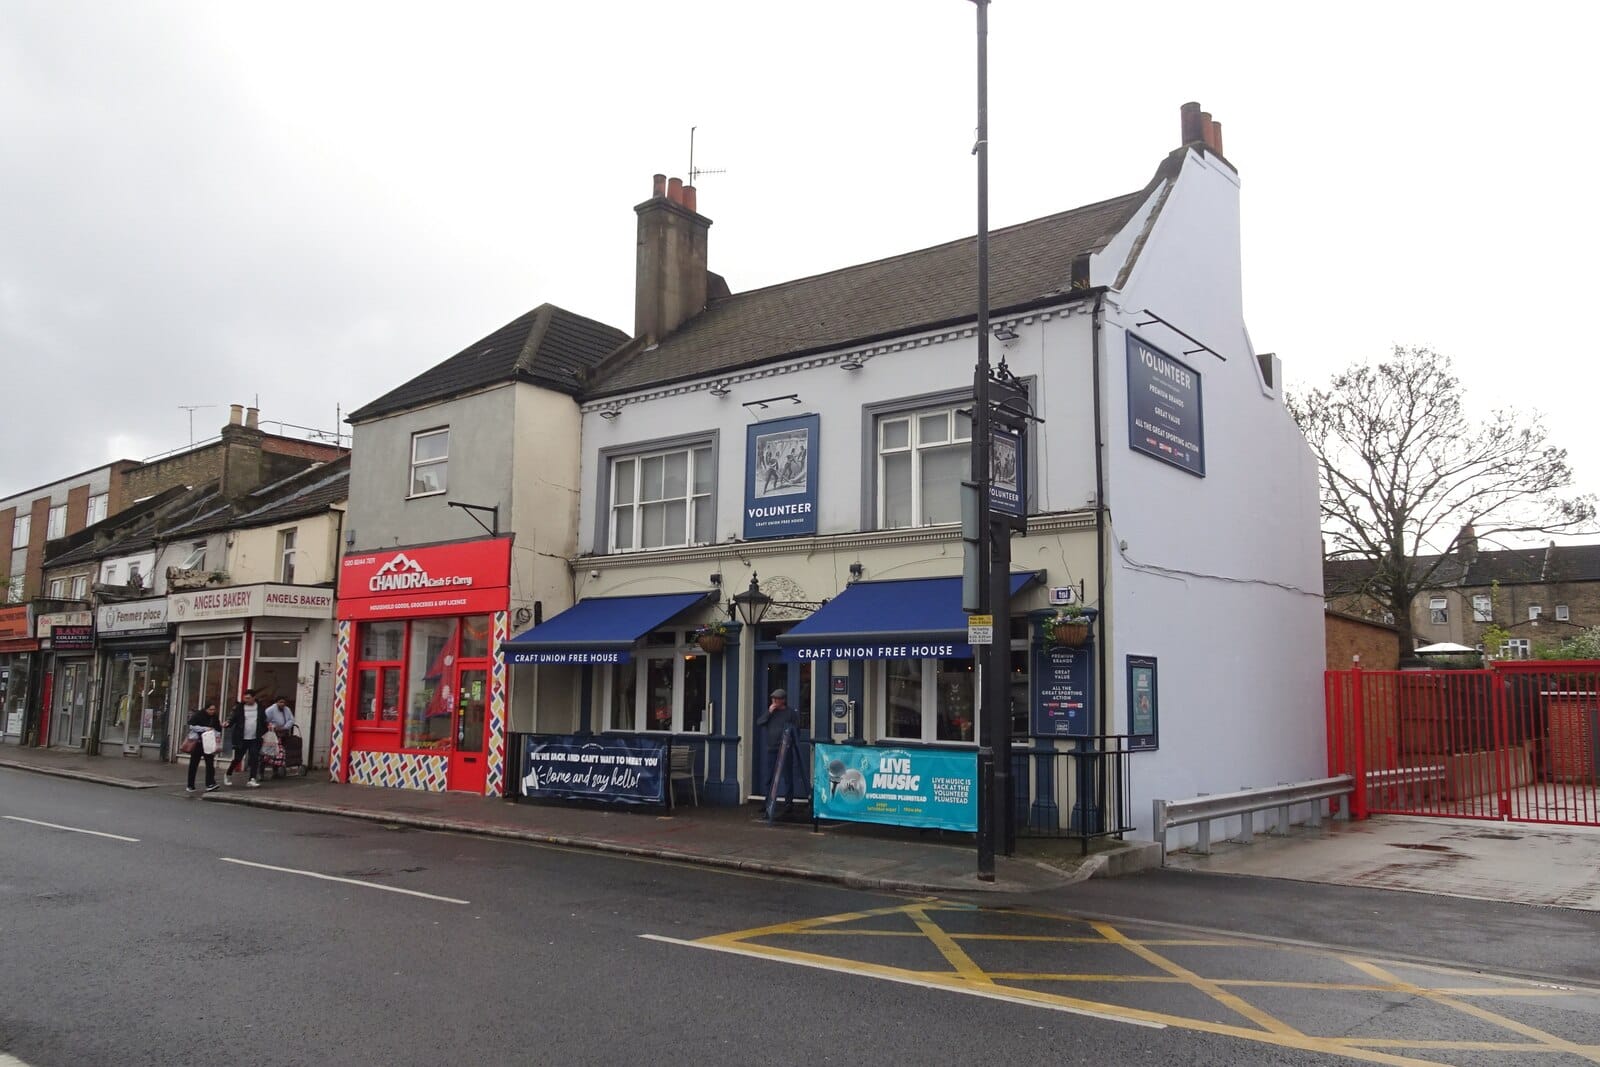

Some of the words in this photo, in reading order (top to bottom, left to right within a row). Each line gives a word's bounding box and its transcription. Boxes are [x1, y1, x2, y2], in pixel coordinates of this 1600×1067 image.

[1138, 347, 1191, 389] VOLUNTEER
[1148, 383, 1168, 399] PREMIUM
[1154, 406, 1169, 419] GREAT
[748, 503, 811, 518] VOLUNTEER
[369, 571, 429, 592] CHANDRA
[452, 575, 473, 587] Carry
[193, 594, 221, 610] ANGELS
[222, 591, 252, 608] BAKERY
[266, 593, 299, 604] ANGELS
[300, 595, 332, 606] BAKERY
[515, 653, 538, 662] CRAFT
[540, 654, 566, 662] UNION
[568, 653, 588, 662] FREE
[590, 653, 618, 662] HOUSE
[798, 649, 832, 658] CRAFT
[836, 647, 873, 657] UNION
[878, 647, 906, 656] FREE
[911, 645, 953, 656] HOUSE
[615, 756, 625, 765] TO
[644, 758, 658, 767] YOU
[880, 758, 911, 774] LIVE
[572, 766, 593, 786] and
[591, 773, 610, 792] say
[610, 766, 641, 789] hello!
[872, 774, 920, 791] MUSIC
[934, 790, 969, 798] VOLUNTEER
[934, 797, 969, 805] PLUMSTEAD
